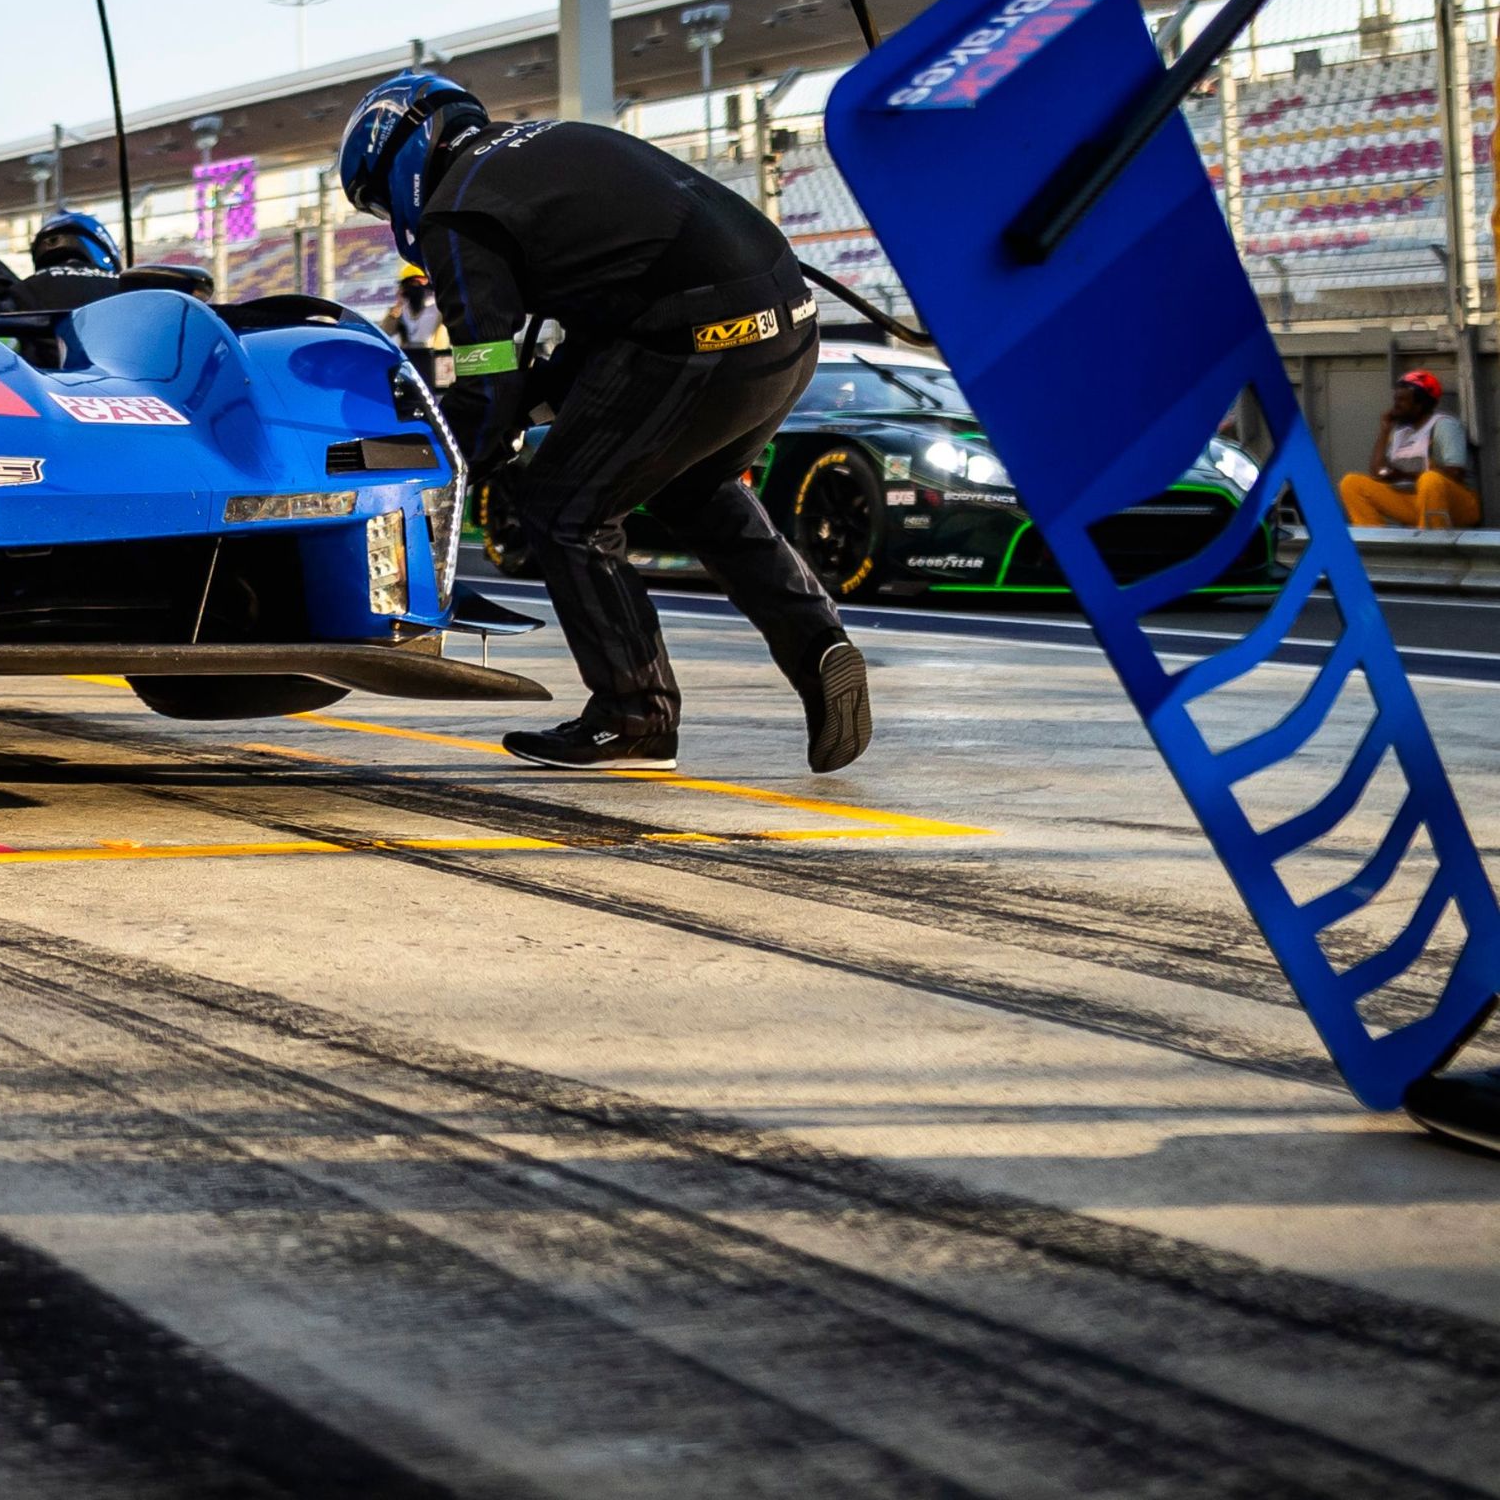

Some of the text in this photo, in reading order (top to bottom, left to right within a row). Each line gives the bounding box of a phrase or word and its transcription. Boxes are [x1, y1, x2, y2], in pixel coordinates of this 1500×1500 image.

[413, 173, 421, 208] OLIVIER
[760, 310, 775, 335] 30
[456, 348, 493, 364] WEC
[58, 396, 164, 407] HYPER
[69, 405, 183, 423] CAR
[907, 554, 985, 570] GOODYEAR
